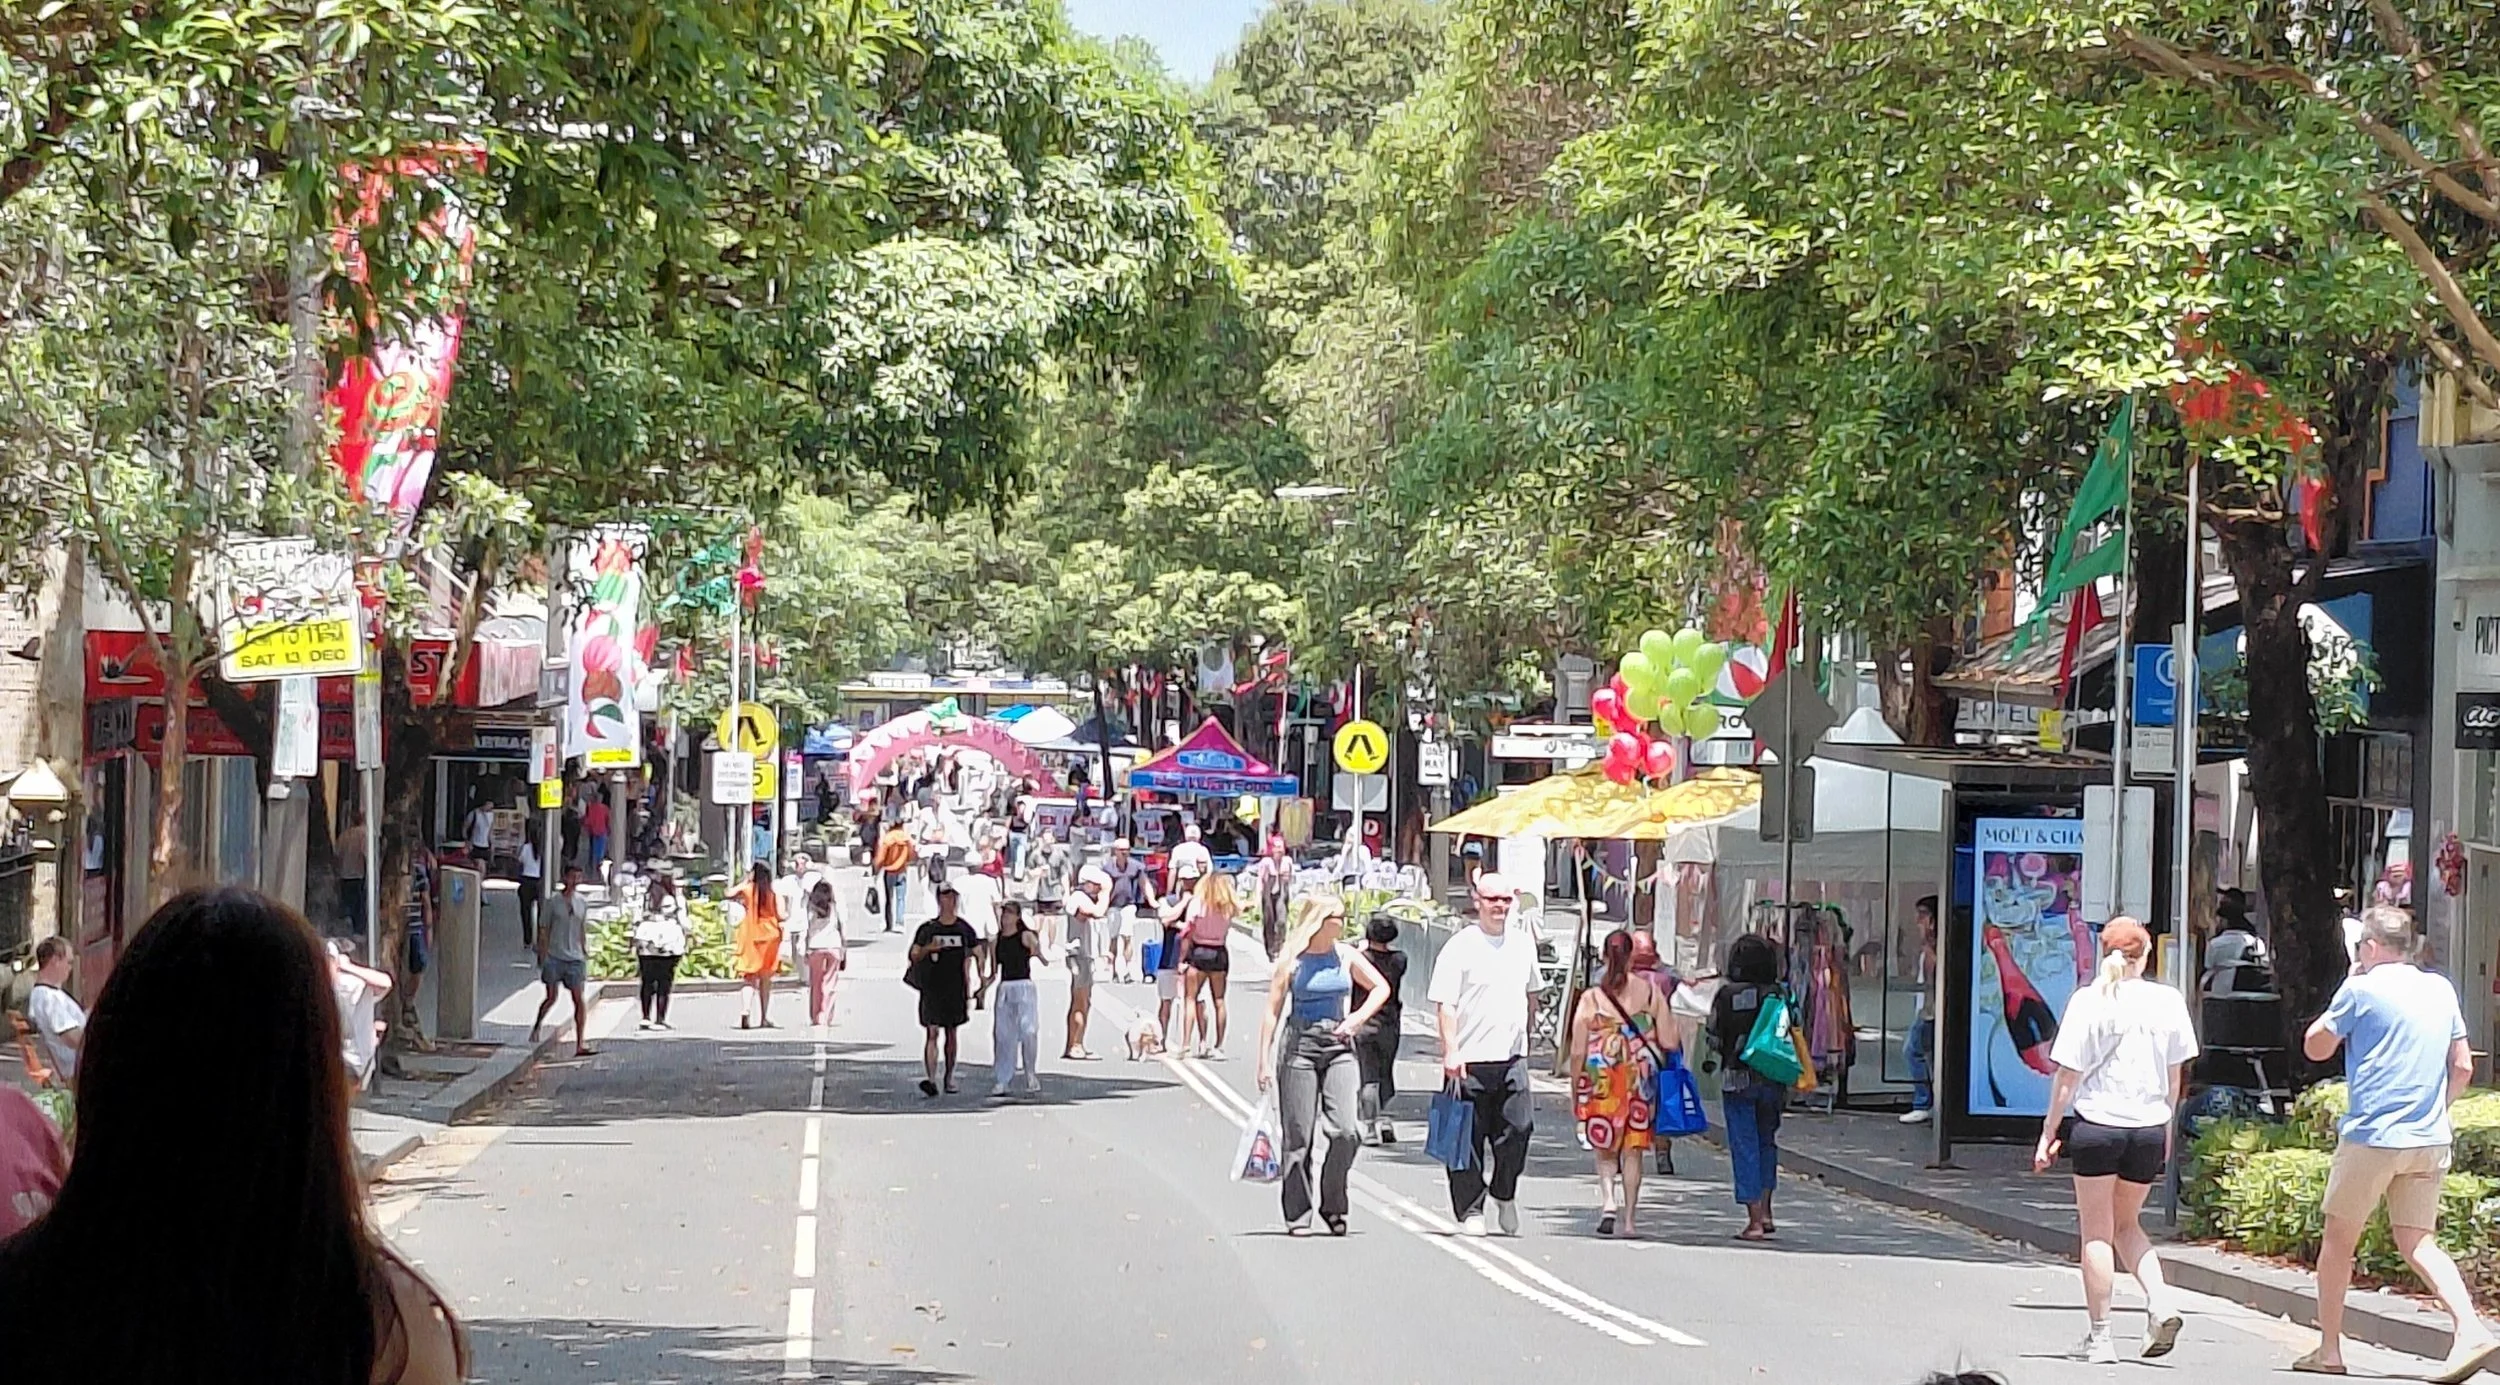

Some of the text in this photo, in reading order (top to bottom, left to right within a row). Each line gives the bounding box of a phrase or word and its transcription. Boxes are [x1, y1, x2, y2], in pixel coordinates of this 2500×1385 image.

[241, 653, 275, 668] SAT
[310, 649, 346, 662] DEC
[2035, 829, 2047, 844] &
